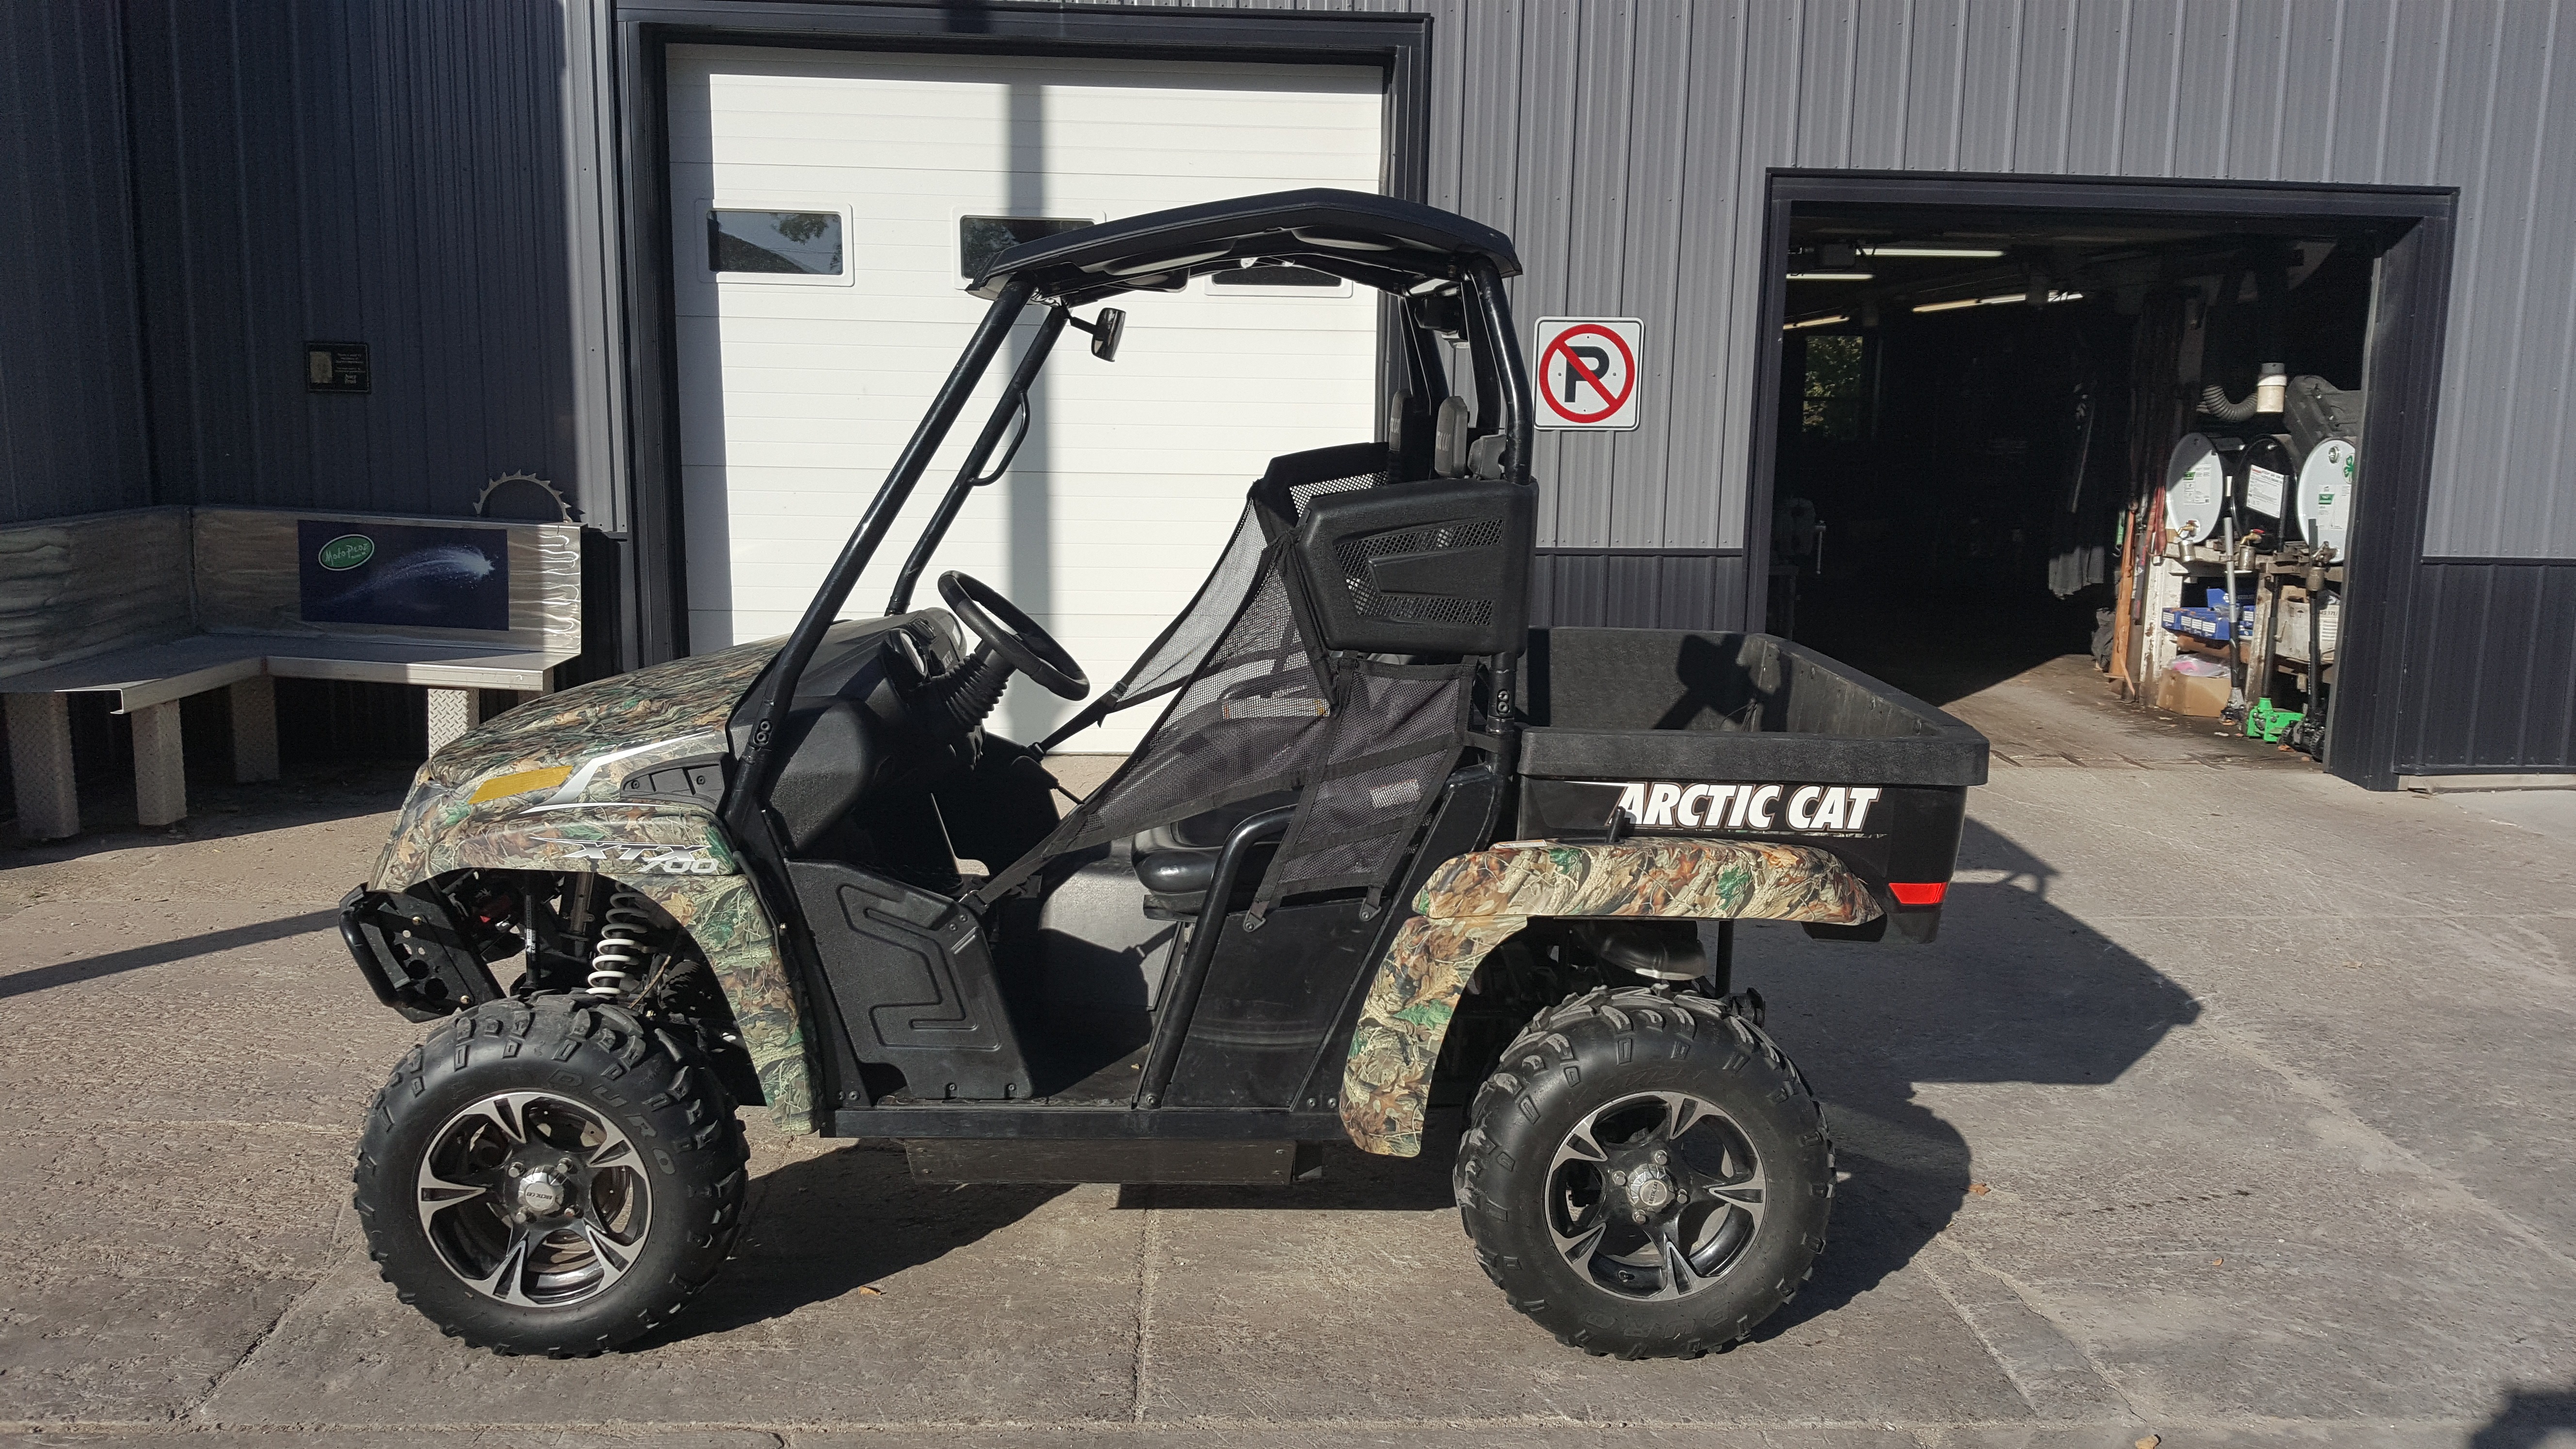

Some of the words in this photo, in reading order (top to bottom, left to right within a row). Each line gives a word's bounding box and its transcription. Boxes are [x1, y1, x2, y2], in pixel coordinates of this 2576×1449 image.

[1607, 782, 1782, 829] ARCTIC
[1786, 785, 1882, 830] CAT
[562, 842, 712, 861] XTX
[636, 857, 720, 873] 700
